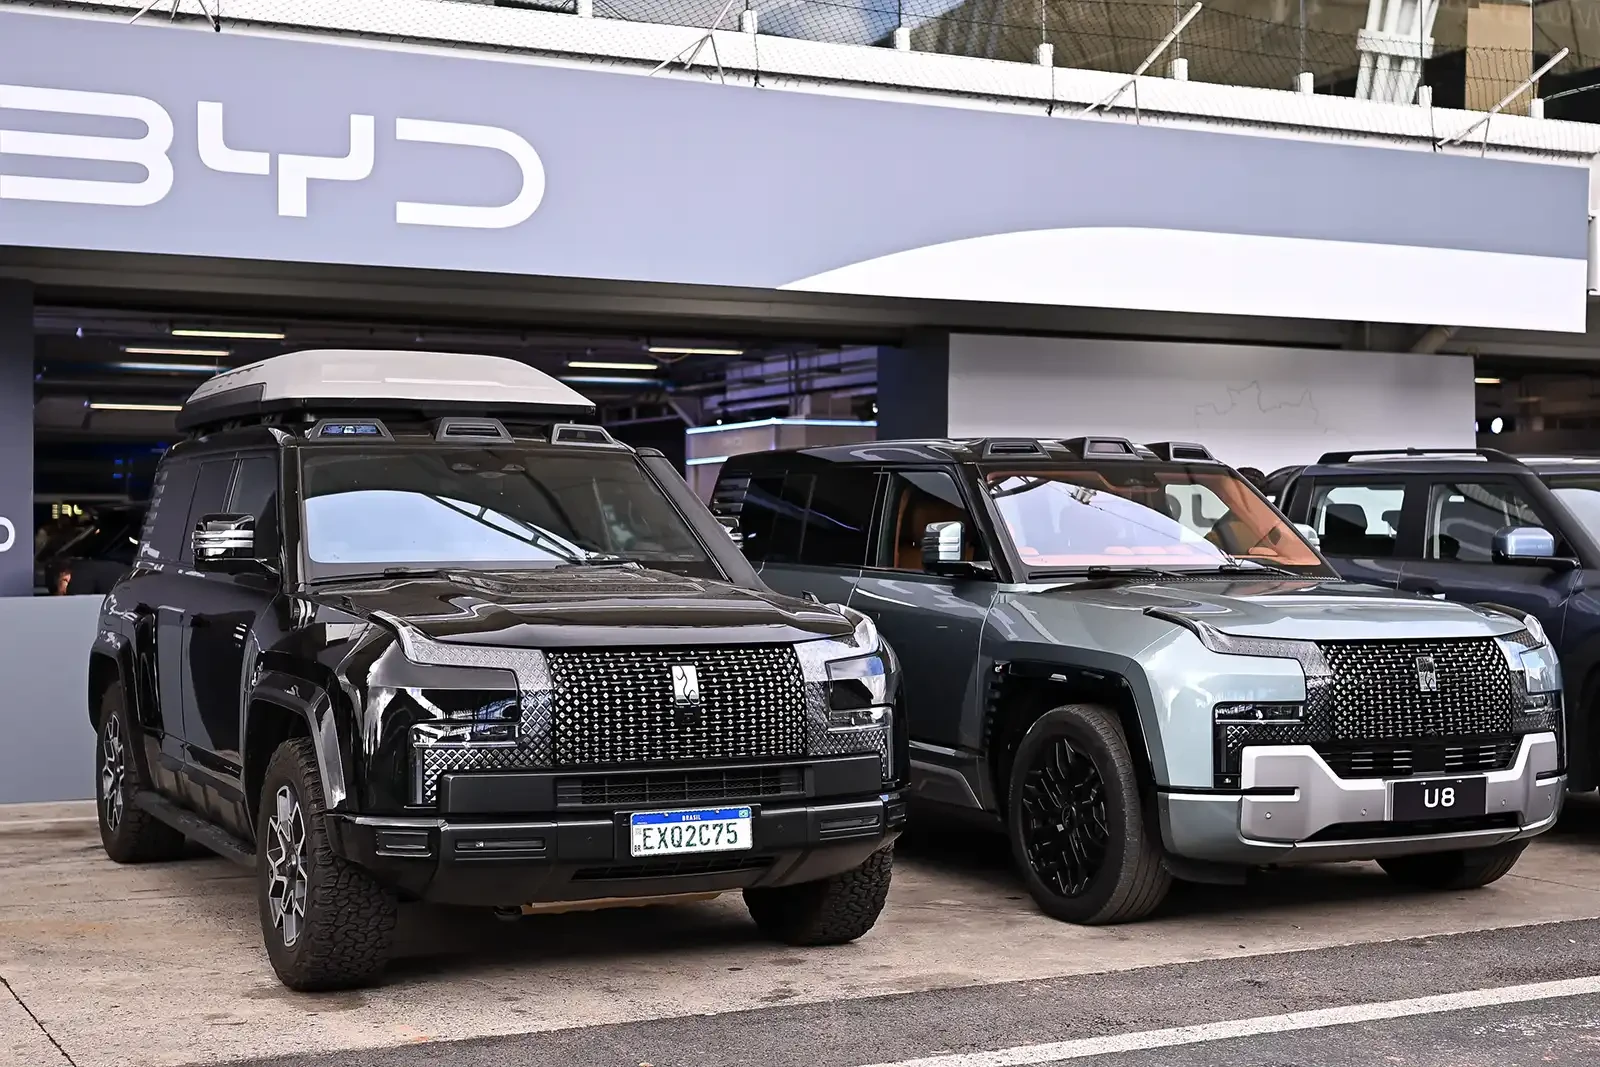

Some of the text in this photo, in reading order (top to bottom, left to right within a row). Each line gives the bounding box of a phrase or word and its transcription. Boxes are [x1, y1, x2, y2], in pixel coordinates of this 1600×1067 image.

[0, 84, 546, 229] BYD
[1424, 787, 1455, 808] U8
[681, 814, 702, 822] BRASIL
[642, 822, 738, 850] EXQ2C75
